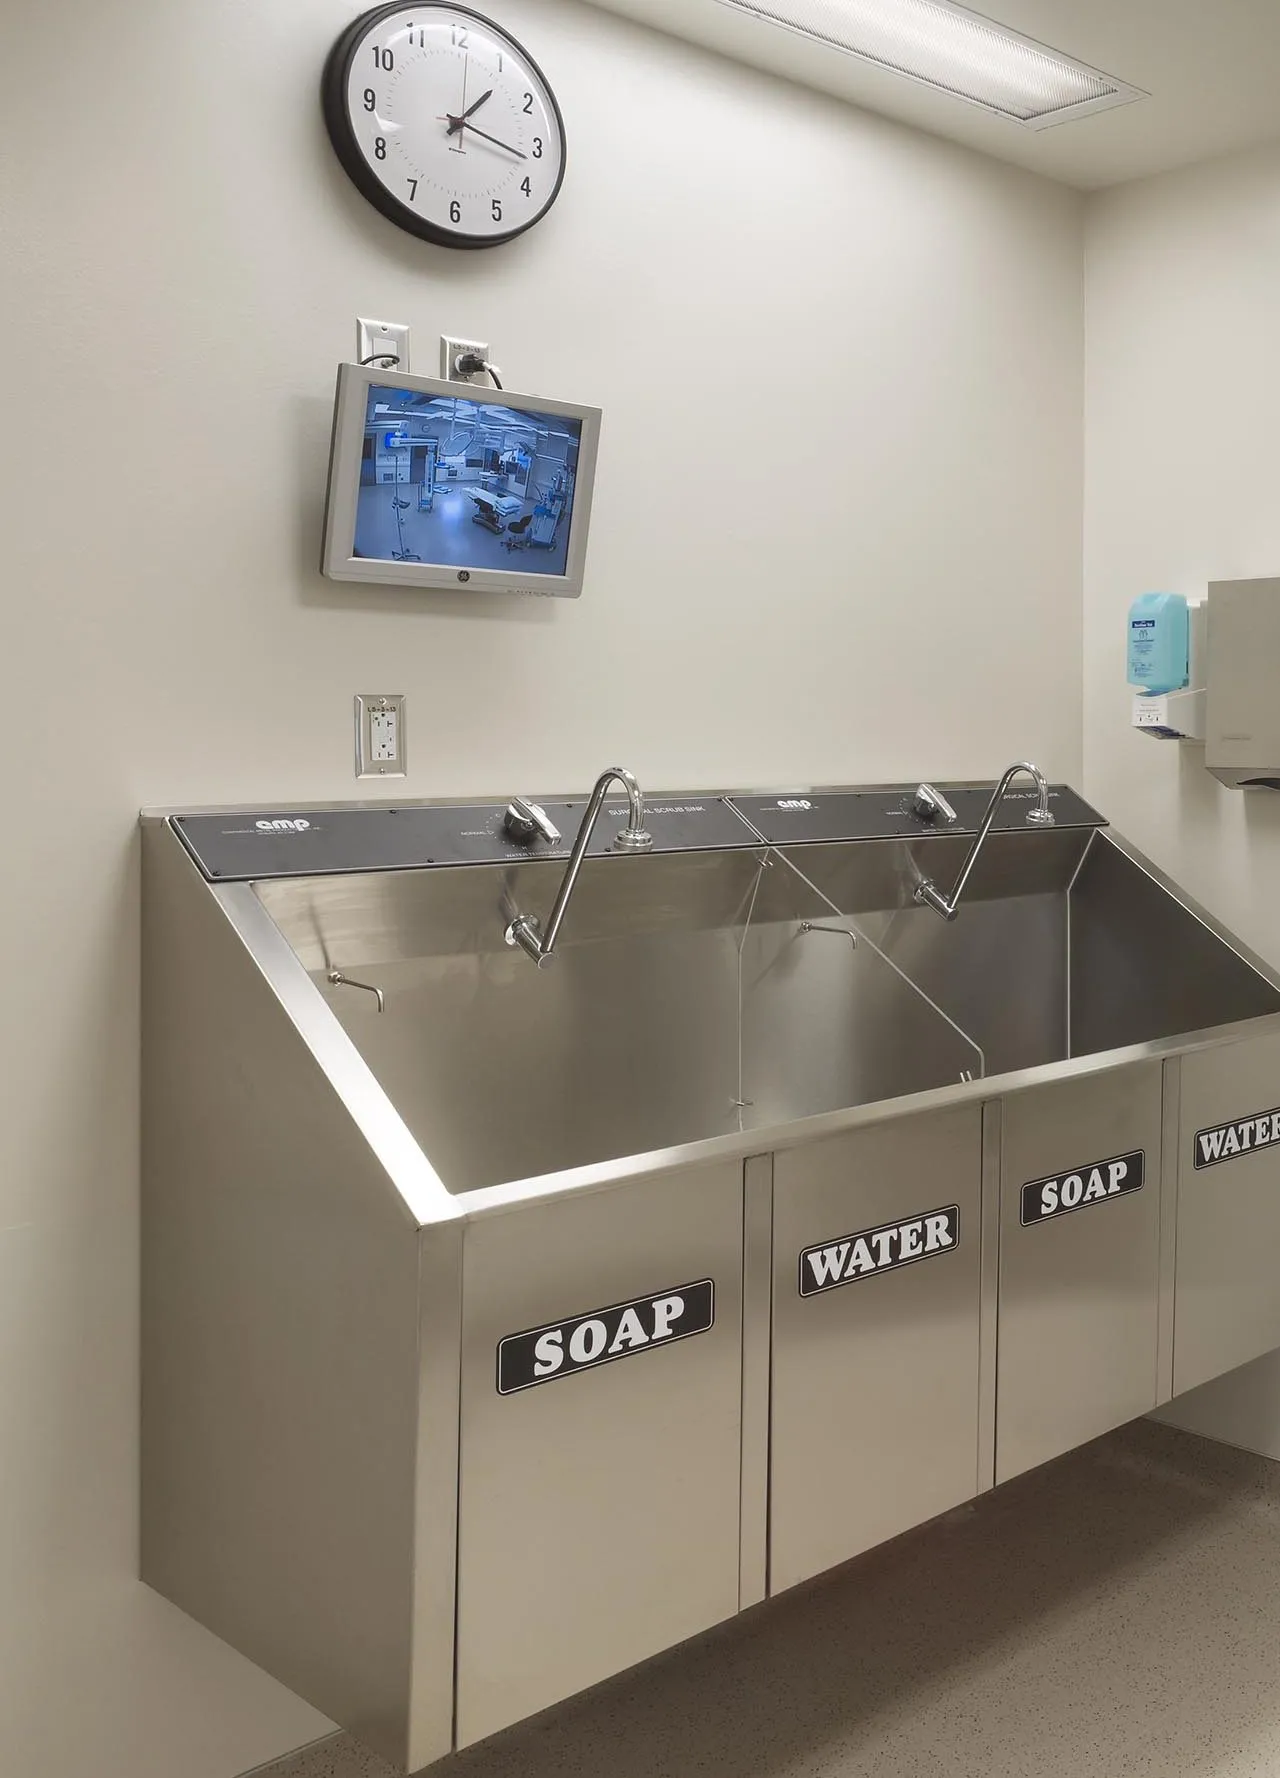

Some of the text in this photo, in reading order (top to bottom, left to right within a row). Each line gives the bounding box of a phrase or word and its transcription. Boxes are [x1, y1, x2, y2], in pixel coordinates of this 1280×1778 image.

[406, 22, 425, 48] 11
[450, 22, 469, 50] 12
[372, 45, 394, 71] 10
[496, 53, 503, 72] 1
[363, 88, 376, 112] 9
[522, 92, 533, 115] 2
[374, 137, 387, 160] 8
[532, 137, 543, 158] 3
[407, 179, 418, 202] 7
[520, 176, 532, 197] 4
[449, 201, 461, 223] 6
[491, 200, 502, 222] 5
[654, 806, 684, 814] SCRUB
[777, 799, 812, 809] amp
[255, 818, 310, 831] amp
[1041, 1161, 1128, 1215] SOAP
[807, 1214, 954, 1286] WATER
[533, 1296, 685, 1376] SOAP
